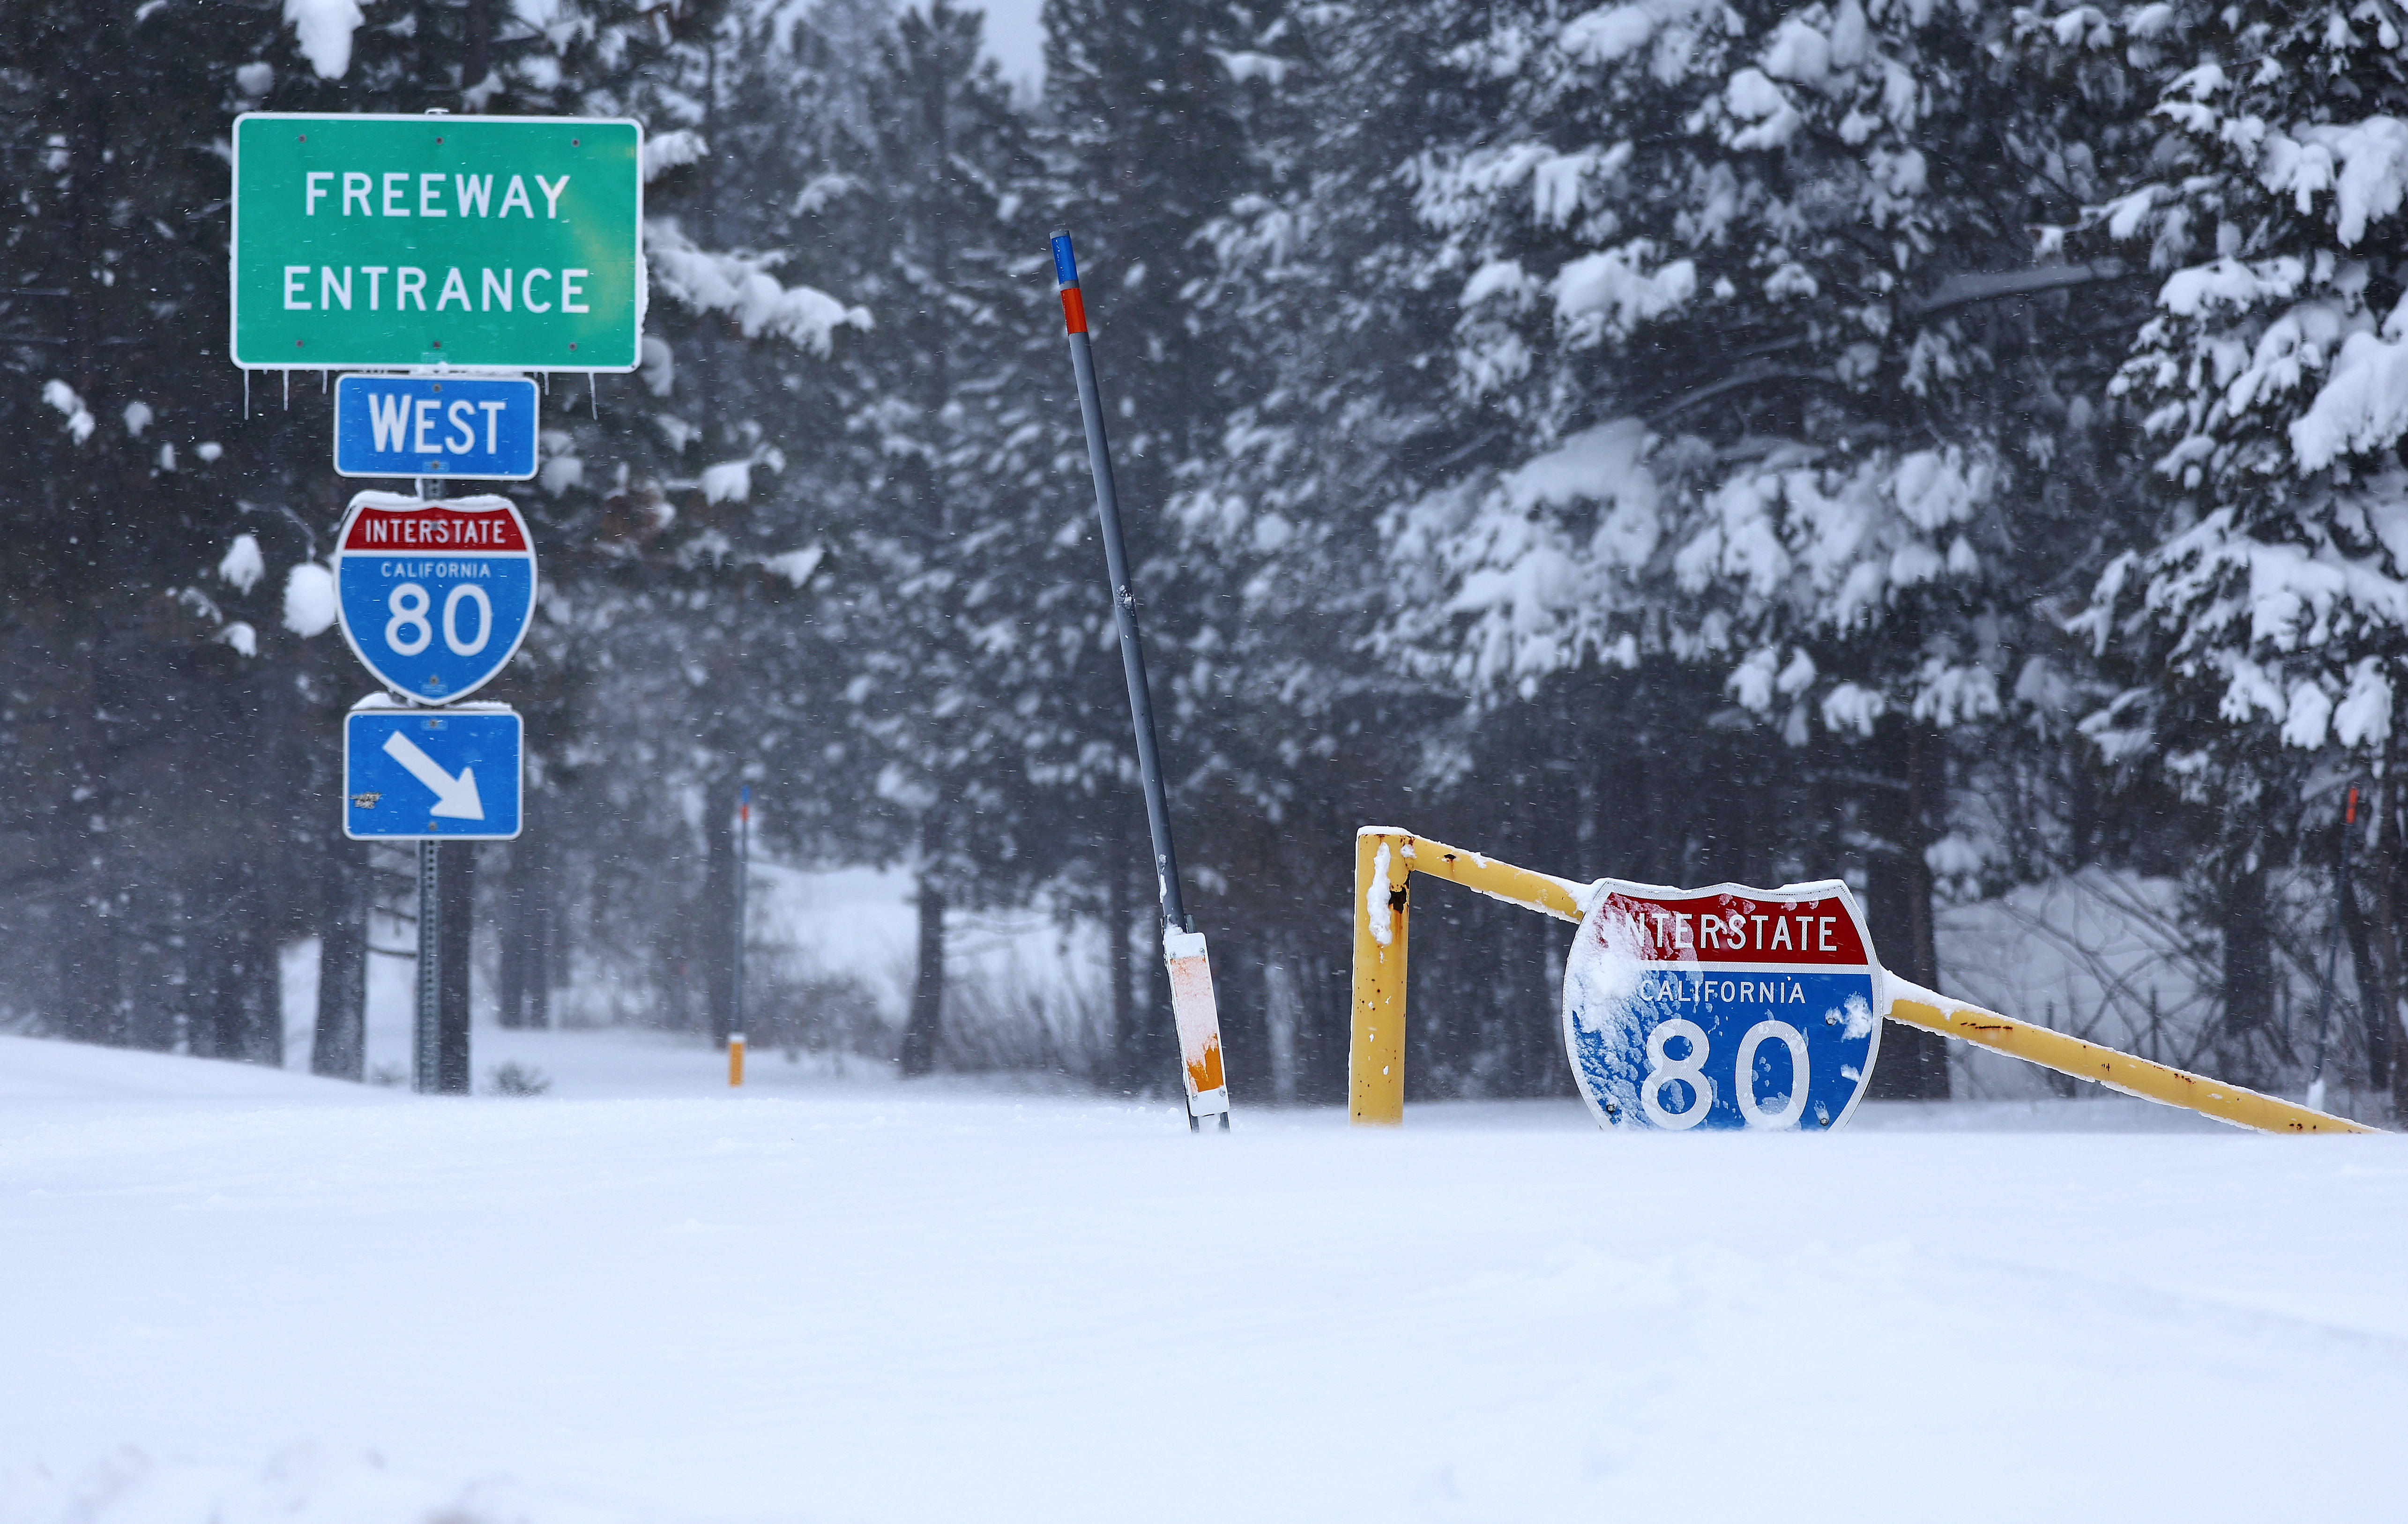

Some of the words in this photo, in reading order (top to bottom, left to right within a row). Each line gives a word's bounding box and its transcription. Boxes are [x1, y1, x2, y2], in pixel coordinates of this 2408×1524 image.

[306, 172, 571, 219] FREEWAY
[283, 266, 589, 313] ENTRANCE
[367, 394, 506, 454] WEST
[365, 519, 506, 544] INTERSTATE
[380, 562, 492, 578] CALIFORNIA
[385, 582, 492, 656] 80
[1610, 912, 1837, 952] NTERSTATE
[1640, 980, 1806, 1004] CALIFORNIA
[1641, 1018, 1810, 1130] 80
